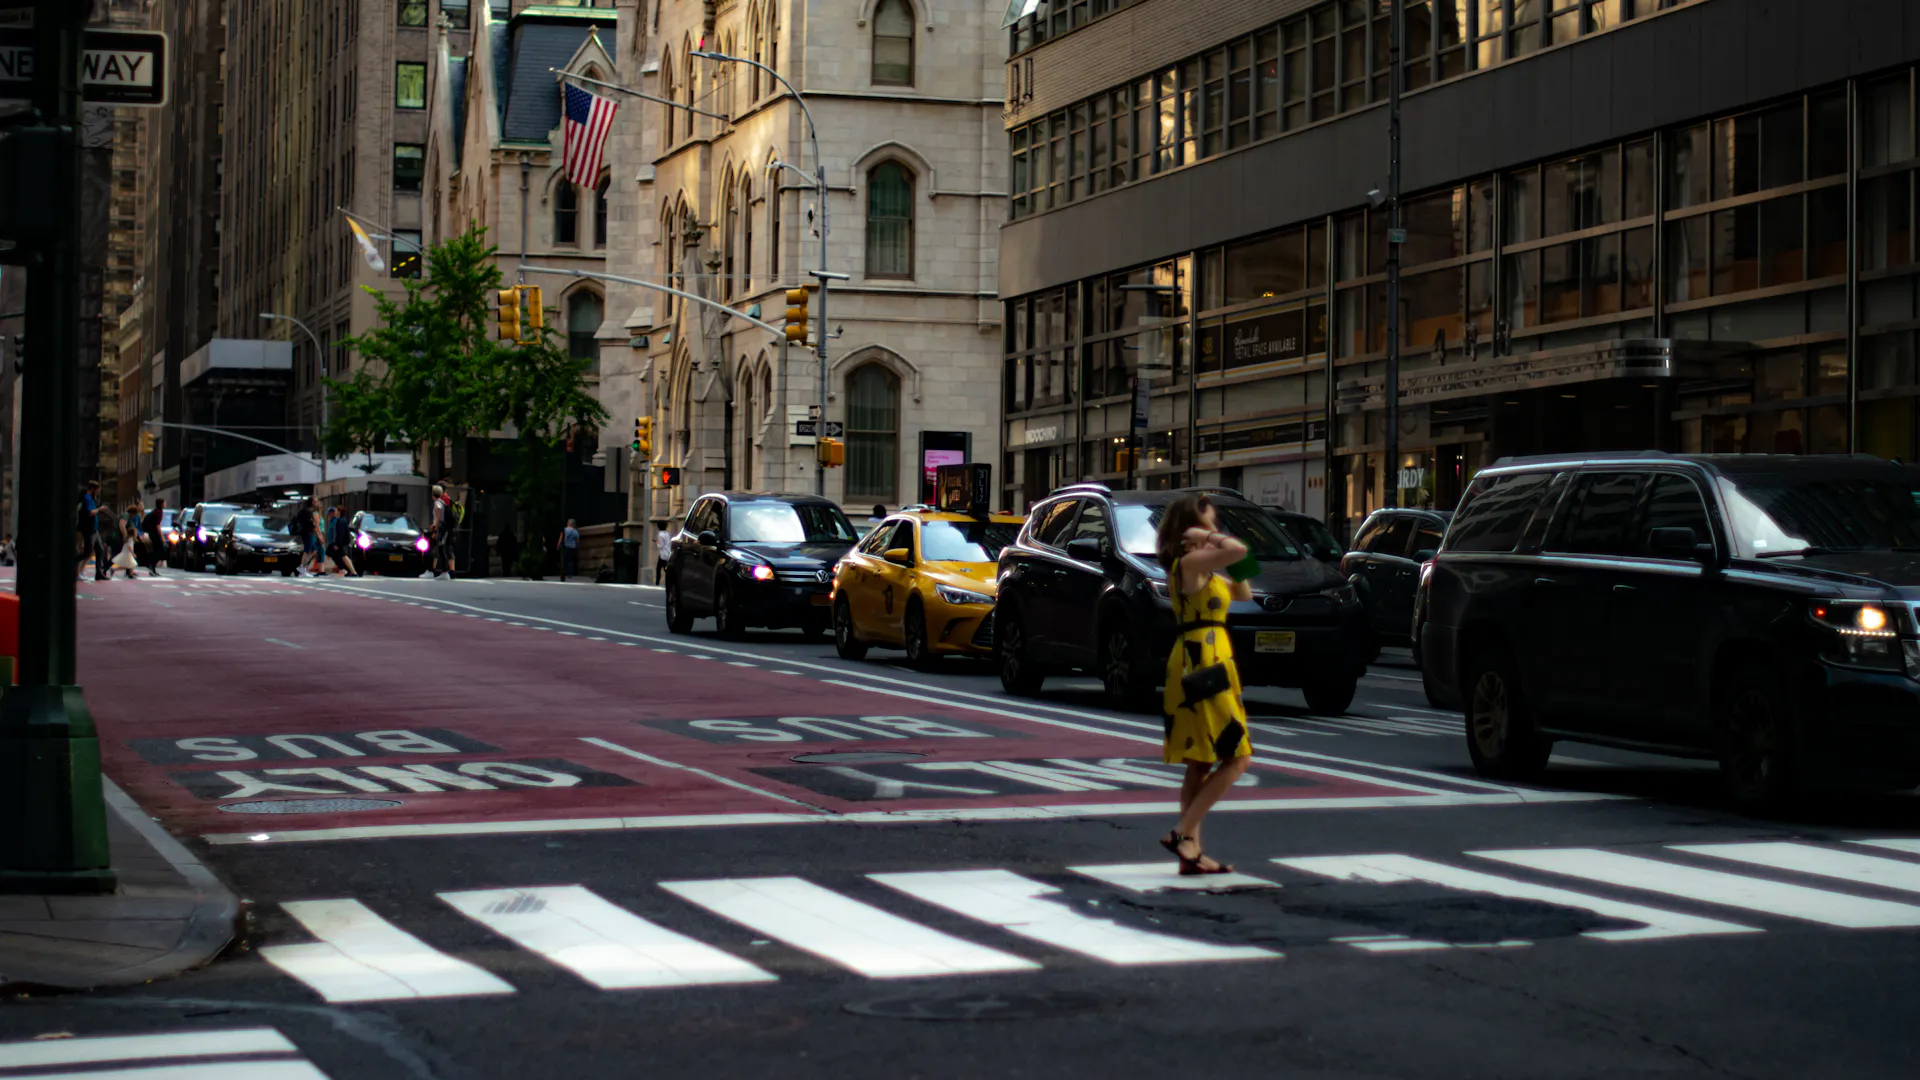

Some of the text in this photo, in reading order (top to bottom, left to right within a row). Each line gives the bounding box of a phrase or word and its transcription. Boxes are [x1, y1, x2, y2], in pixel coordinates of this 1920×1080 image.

[0, 50, 33, 78] NE
[1252, 342, 1267, 357] SPACE
[1268, 336, 1296, 354] AVAILABLE
[689, 716, 994, 741] BUS
[176, 730, 460, 761] BUS
[216, 762, 582, 798] ONLY
